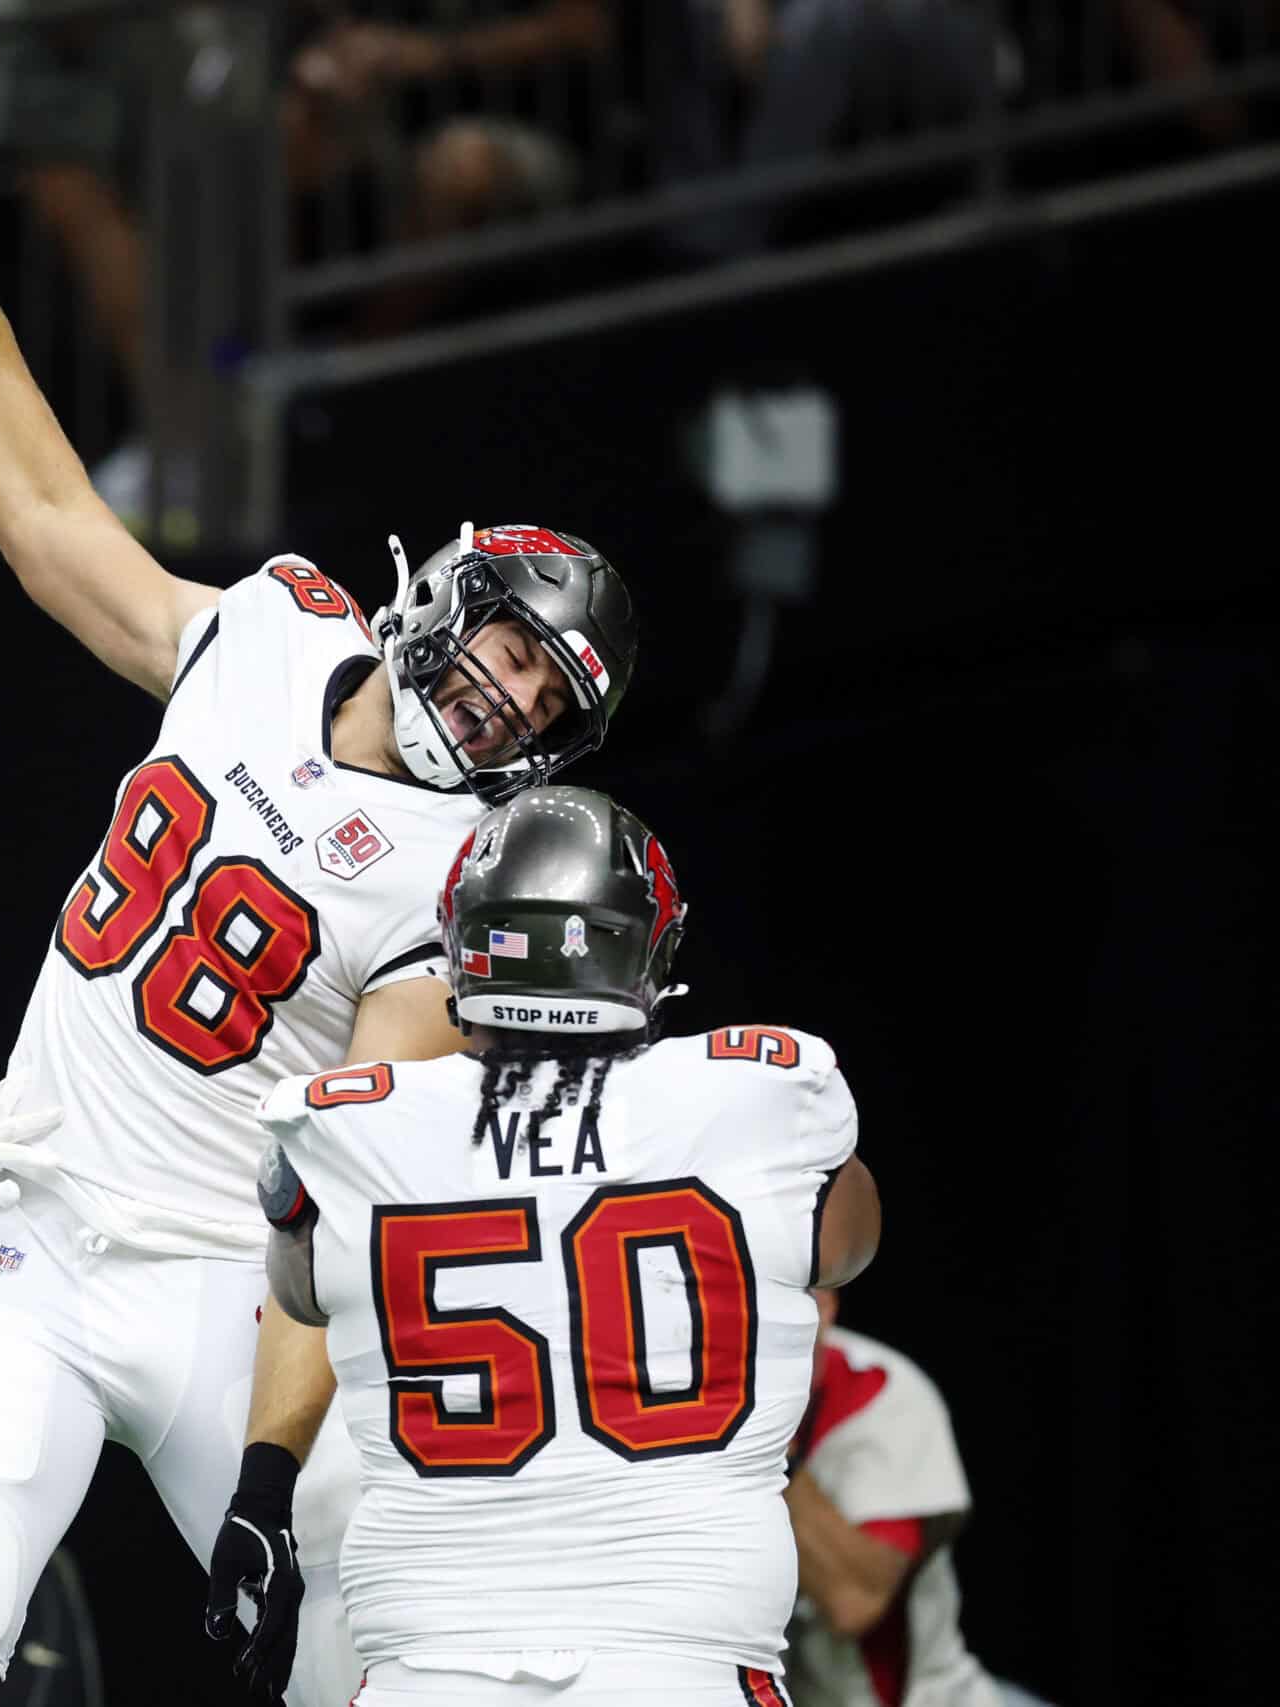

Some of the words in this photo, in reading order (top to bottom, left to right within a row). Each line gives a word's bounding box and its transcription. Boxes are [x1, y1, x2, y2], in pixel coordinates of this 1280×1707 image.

[224, 761, 304, 856] BUCCANEERS
[334, 816, 382, 863] 50
[55, 754, 321, 1076] 98
[493, 1006, 542, 1023] STOP
[548, 1010, 599, 1025] HATE
[305, 1063, 395, 1110] 0
[486, 1105, 607, 1180] VEA
[370, 1176, 758, 1478] 50
